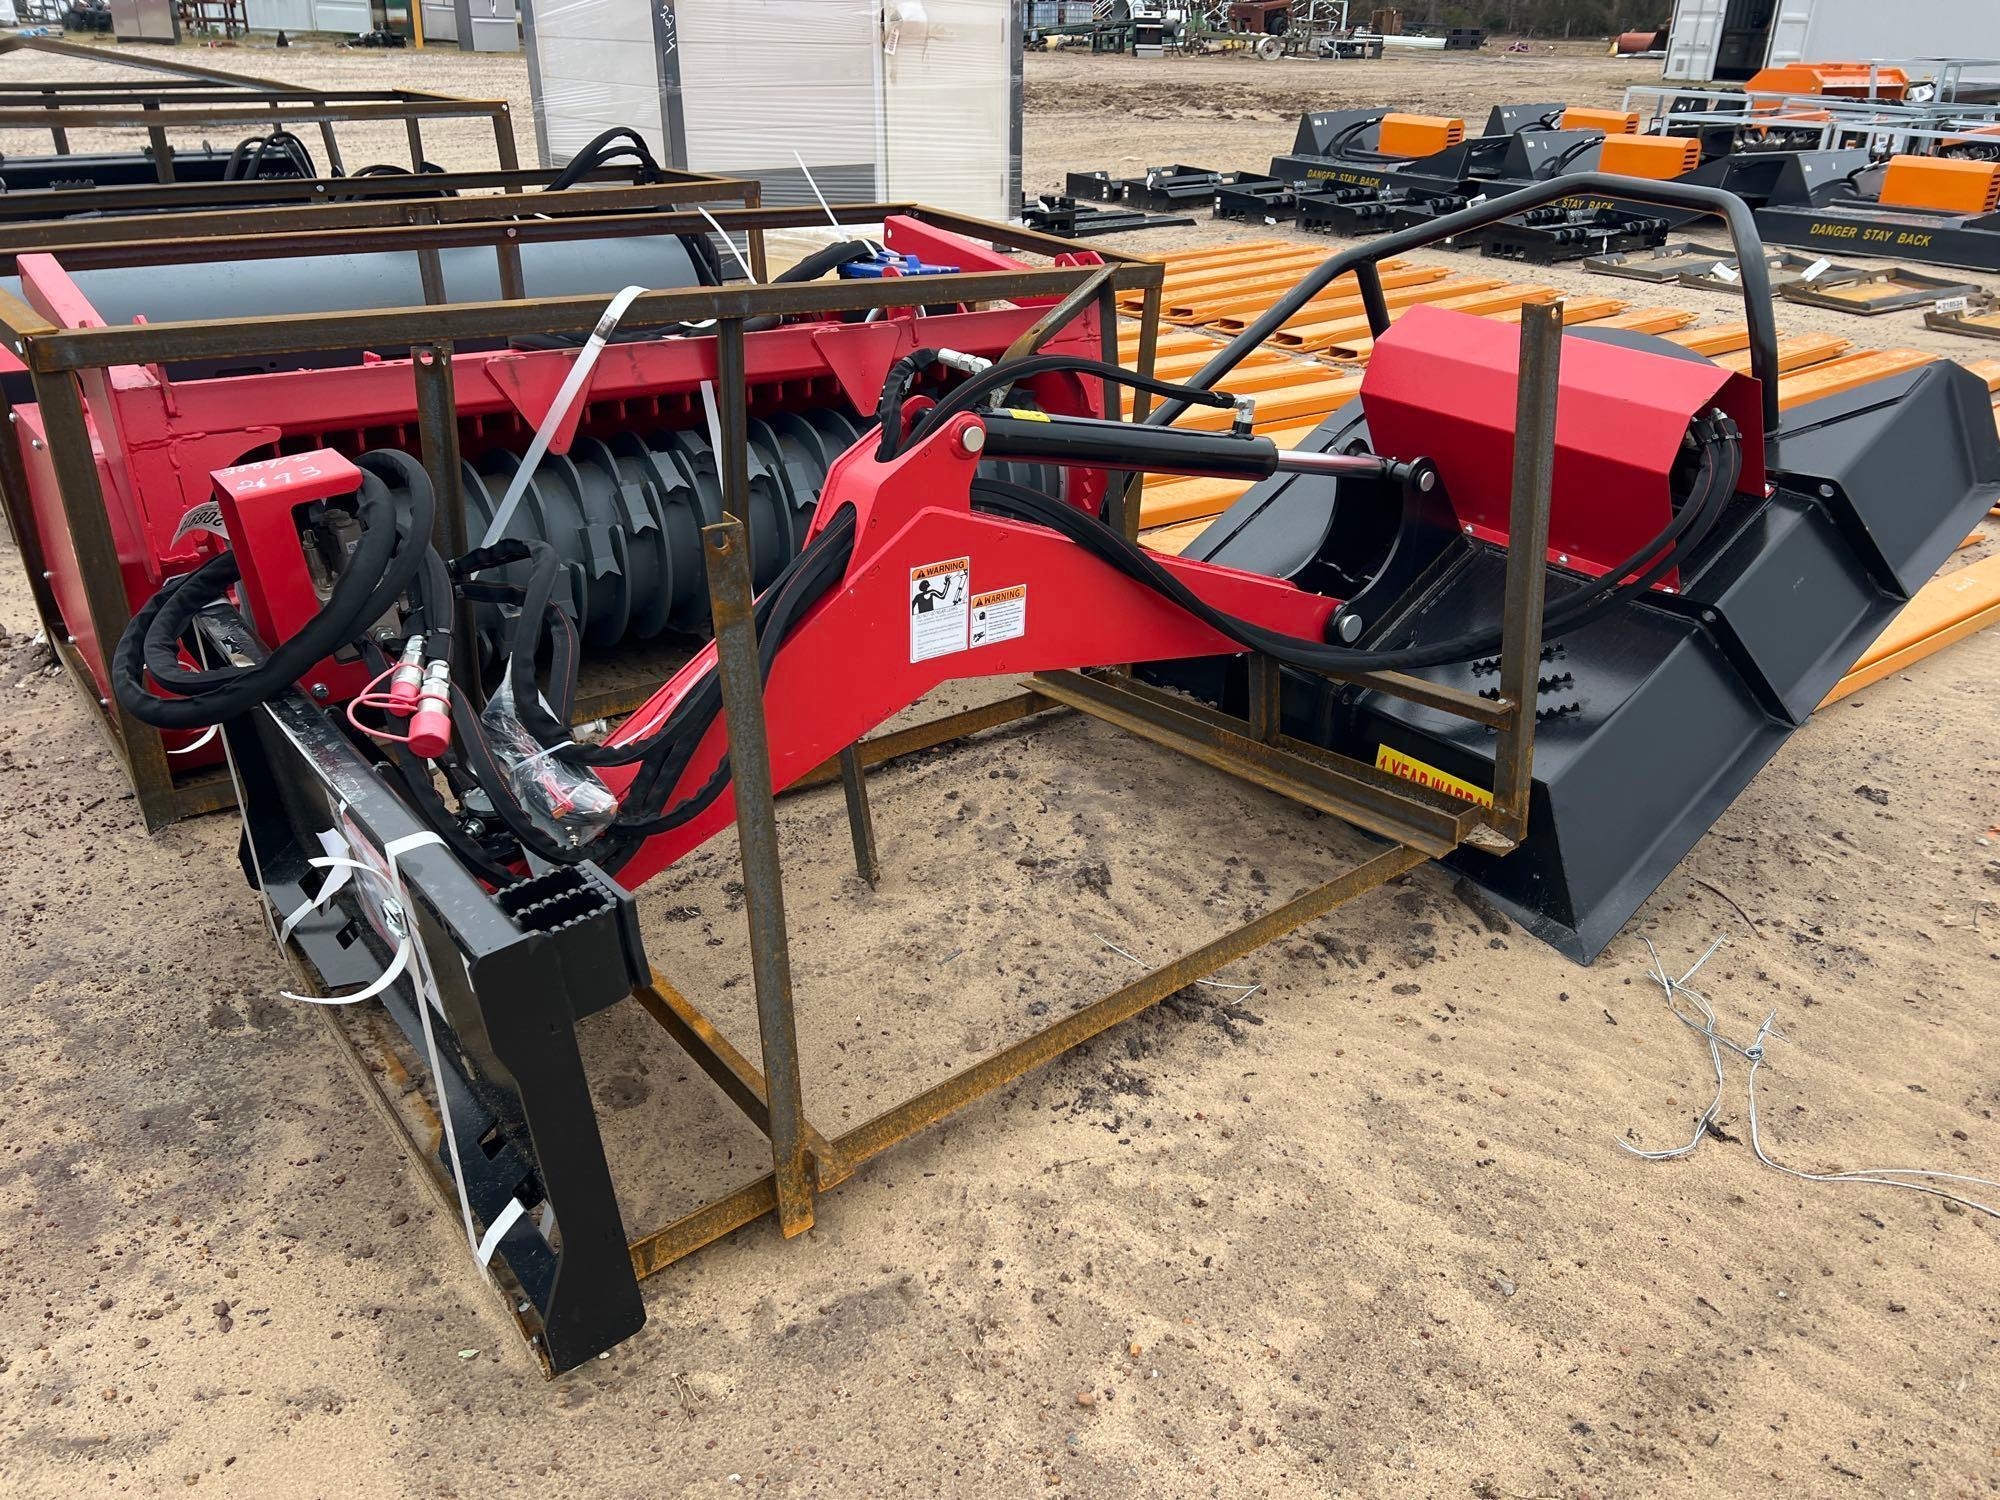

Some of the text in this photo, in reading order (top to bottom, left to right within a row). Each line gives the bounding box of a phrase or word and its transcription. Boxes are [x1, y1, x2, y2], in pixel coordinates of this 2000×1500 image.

[1307, 169, 1381, 187] DANGER STAY BACK
[1562, 198, 1585, 209] STAY
[1589, 200, 1615, 210] BACK
[1810, 223, 1932, 247] DANGER STAY BACK
[926, 561, 965, 576] WARNING
[984, 589, 1020, 604] WARNING
[1379, 754, 1387, 771] 1
